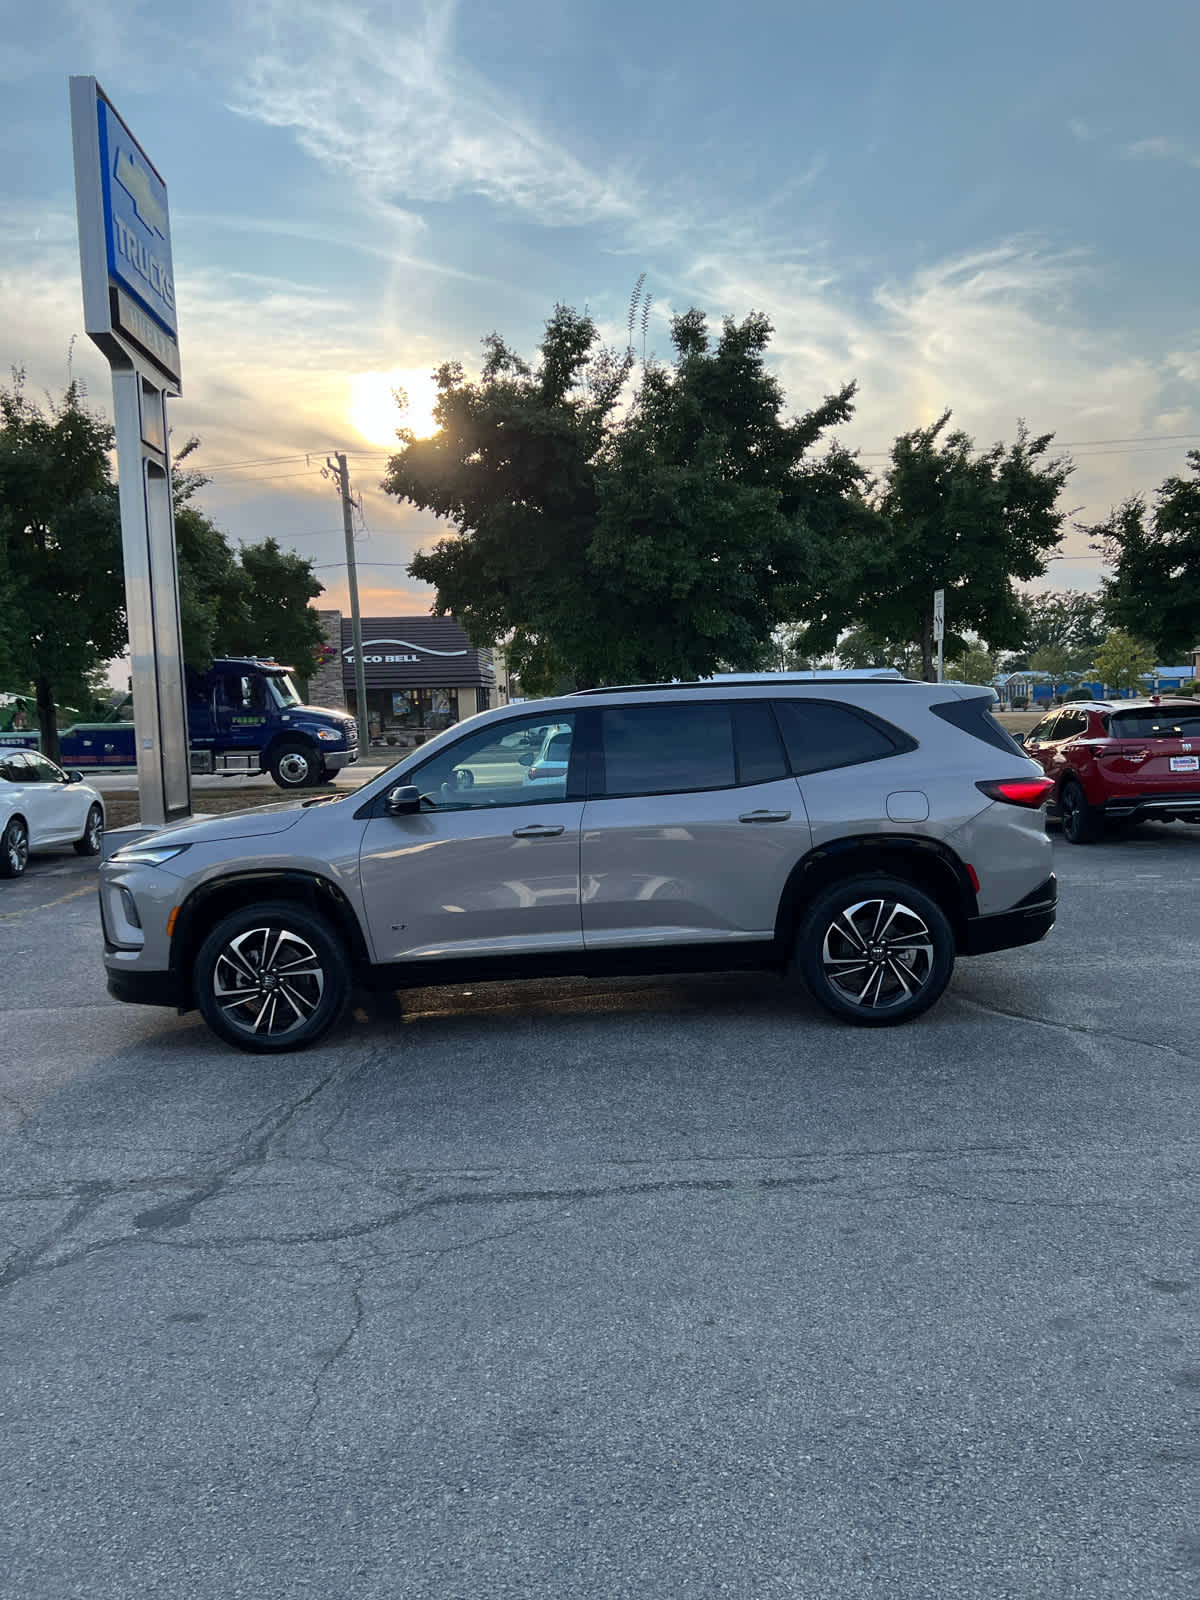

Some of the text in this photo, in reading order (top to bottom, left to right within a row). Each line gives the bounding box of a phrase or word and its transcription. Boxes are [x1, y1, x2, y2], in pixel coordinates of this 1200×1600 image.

[113, 212, 174, 311] TRUCKS
[344, 654, 421, 664] TCO BELL
